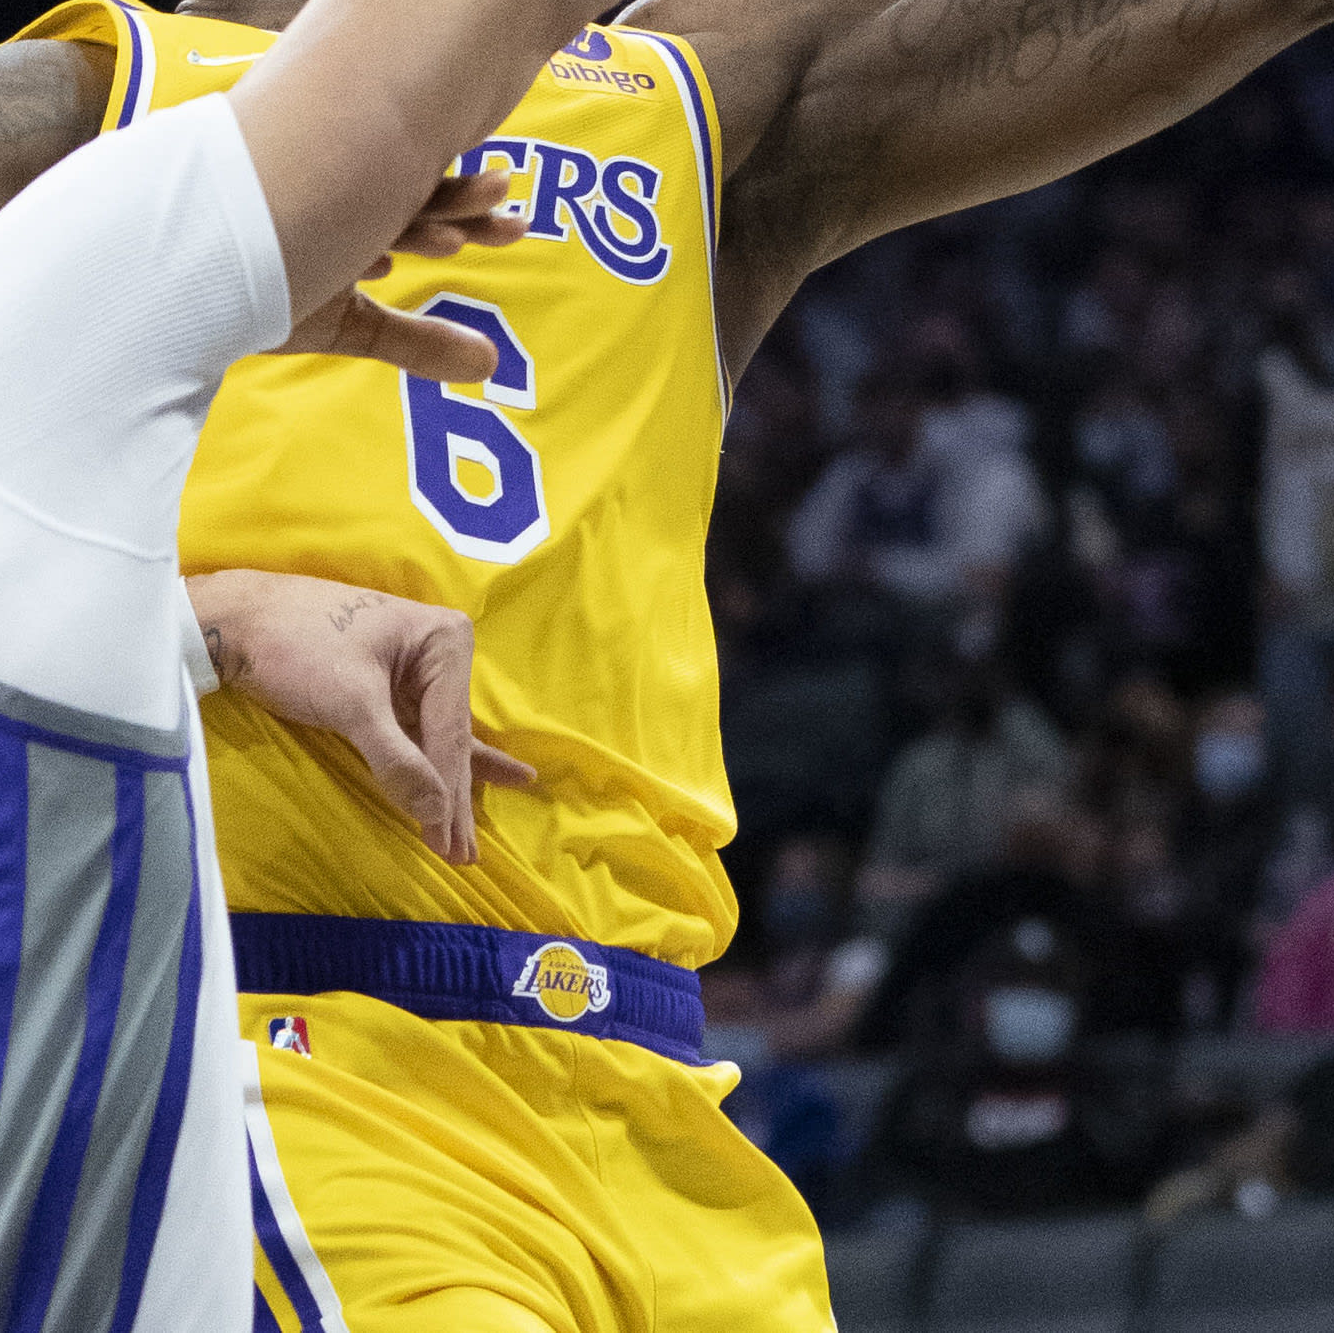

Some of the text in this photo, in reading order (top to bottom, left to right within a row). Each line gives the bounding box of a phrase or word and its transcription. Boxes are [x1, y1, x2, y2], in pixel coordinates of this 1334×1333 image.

[547, 58, 656, 94] bibigo
[399, 291, 550, 565] 6
[516, 959, 606, 1008] LAKERS
